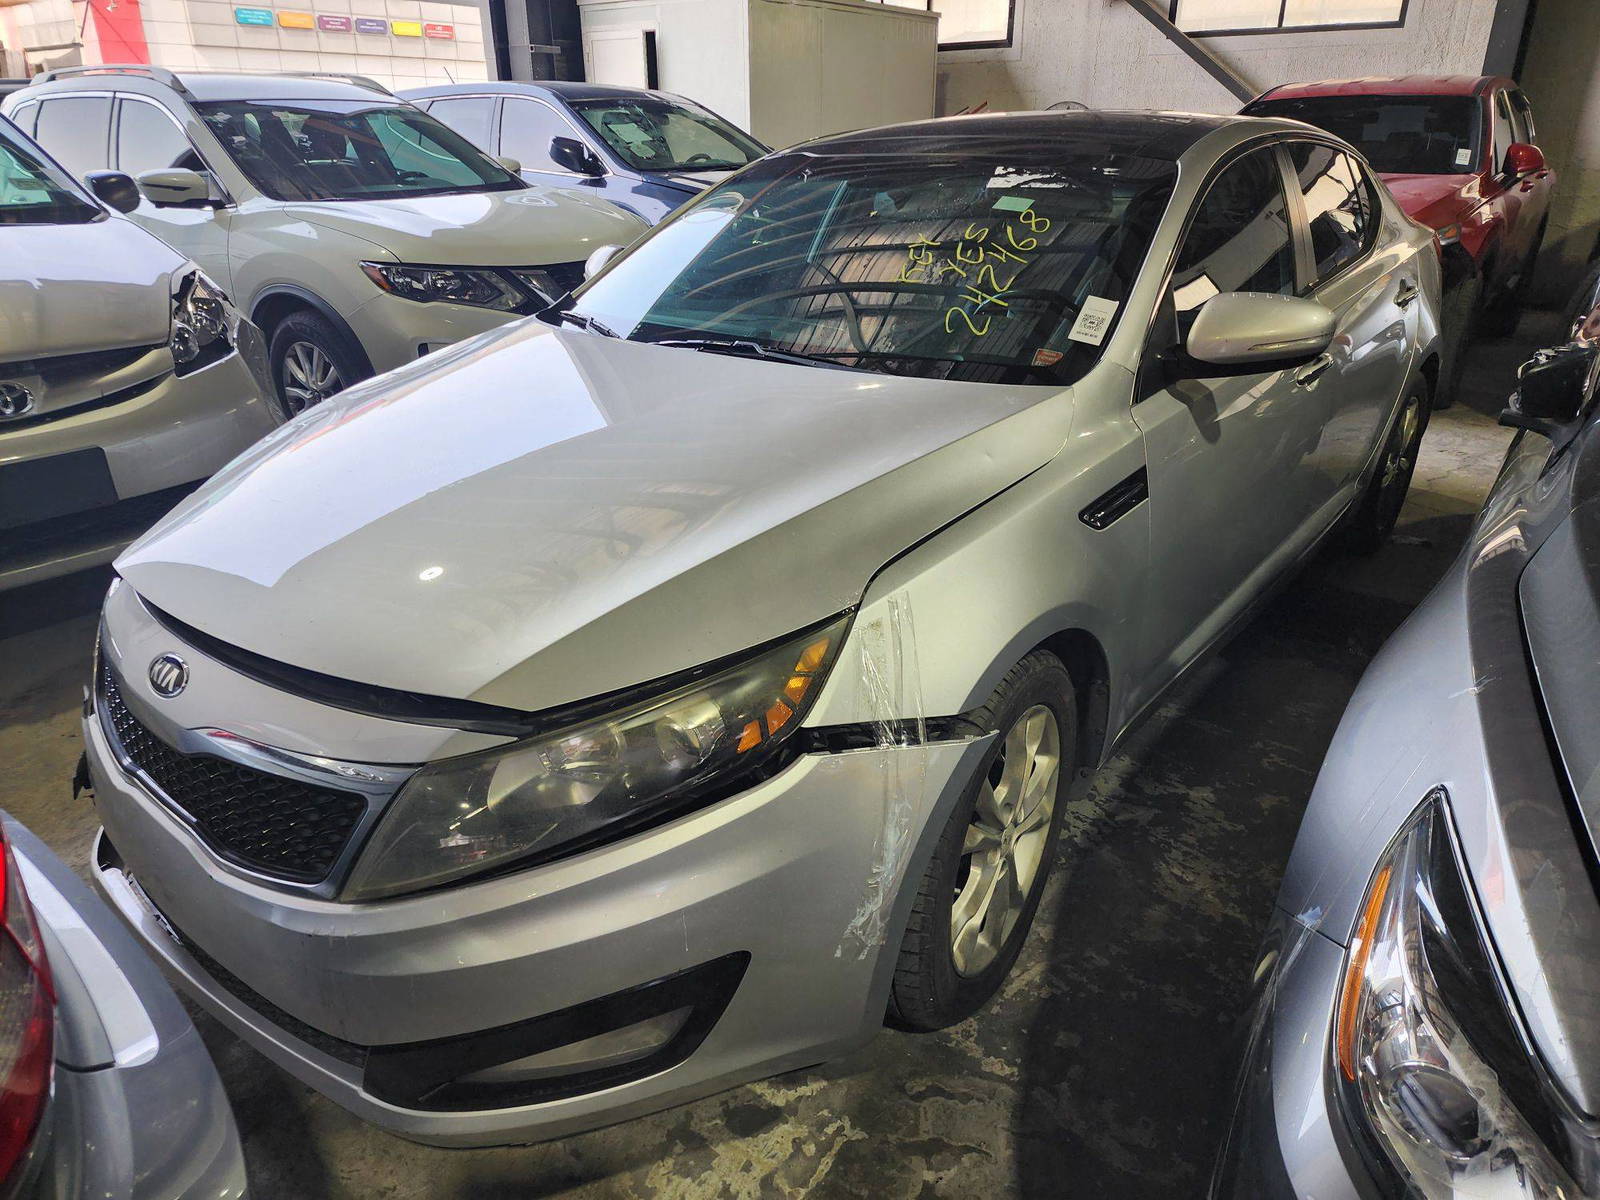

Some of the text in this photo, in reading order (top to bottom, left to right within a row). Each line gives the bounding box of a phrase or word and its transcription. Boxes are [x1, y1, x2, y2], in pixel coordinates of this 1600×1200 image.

[939, 222, 989, 278] YES
[945, 209, 1051, 336] 242468
[152, 662, 180, 692] KIA
